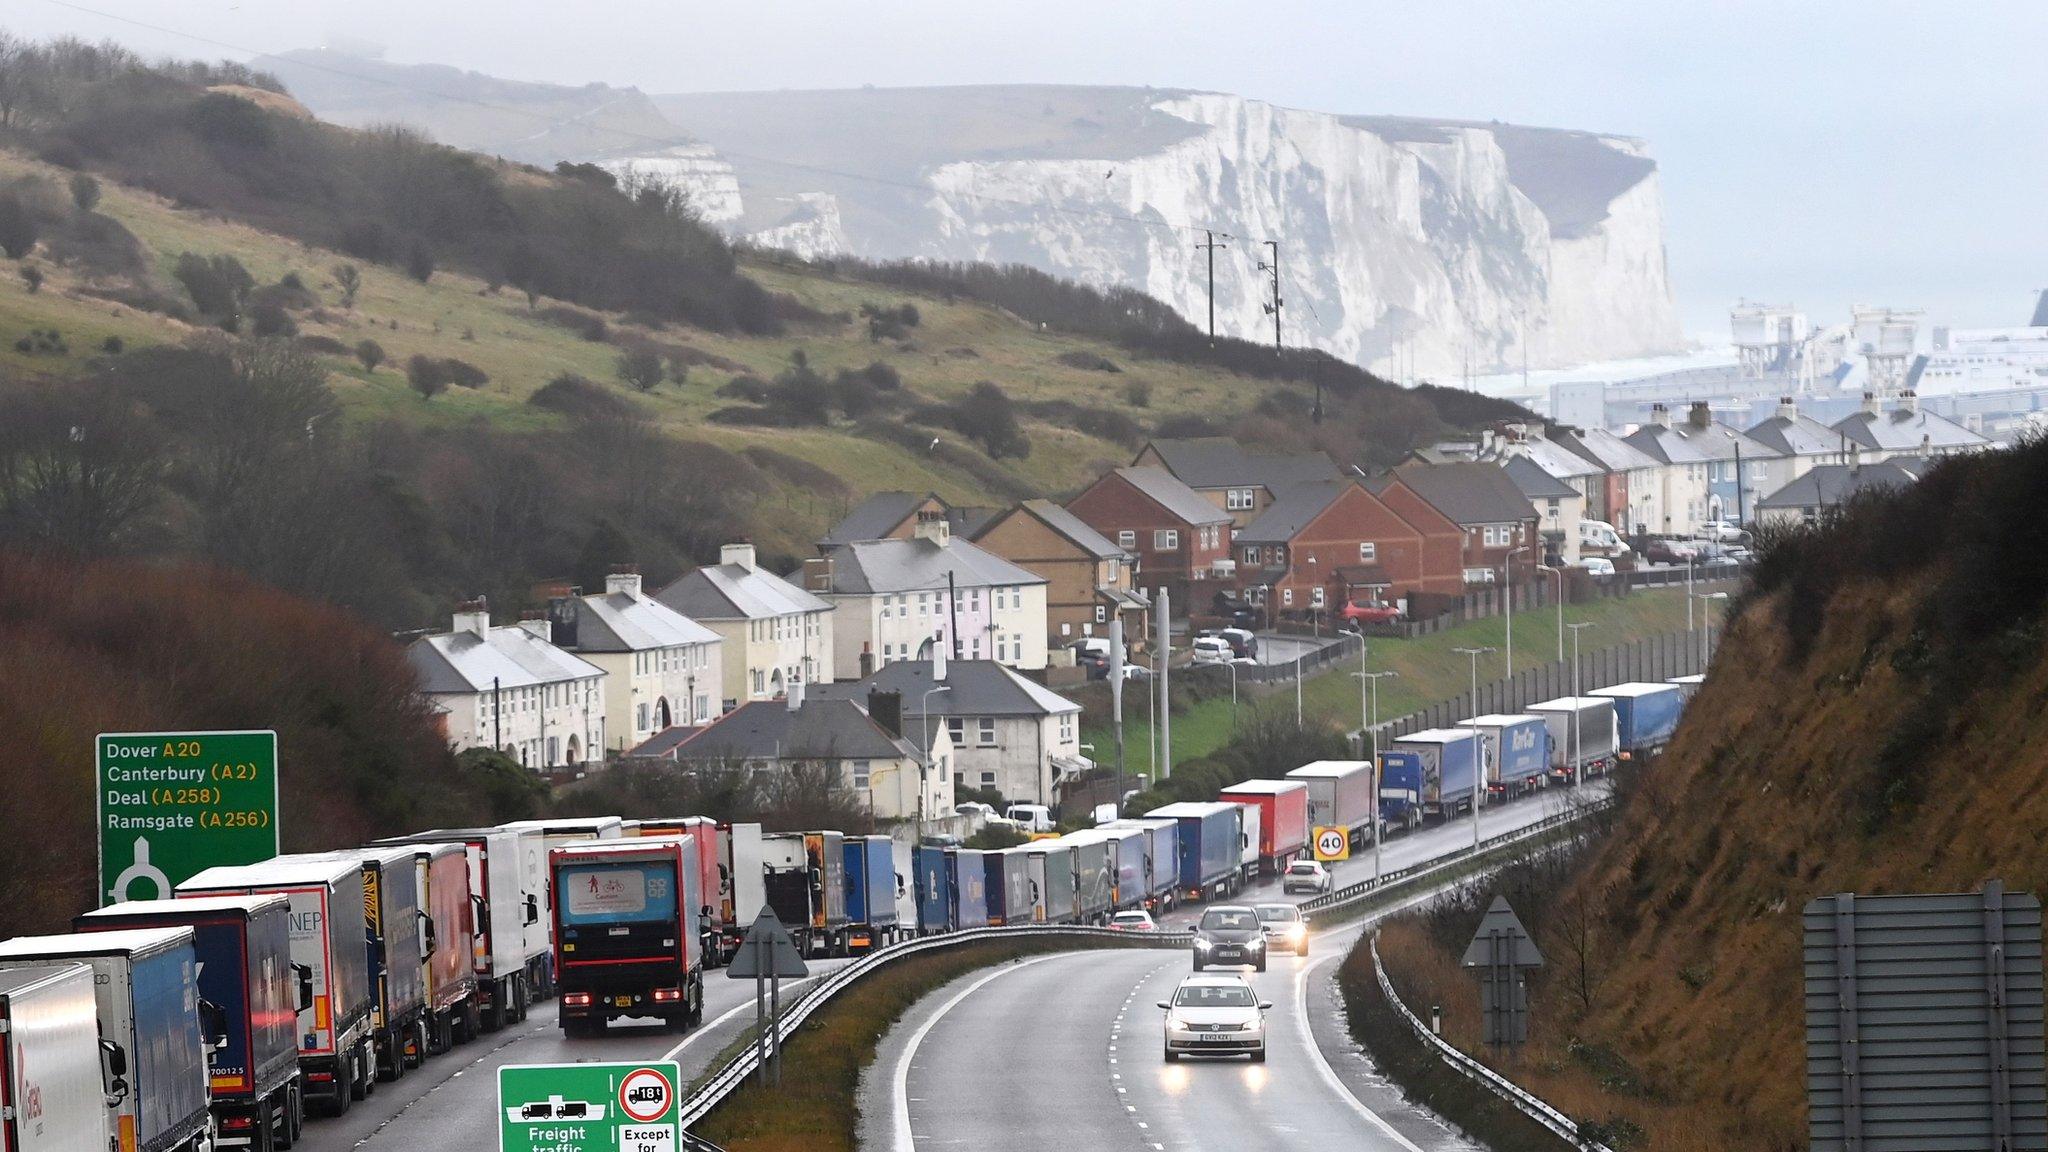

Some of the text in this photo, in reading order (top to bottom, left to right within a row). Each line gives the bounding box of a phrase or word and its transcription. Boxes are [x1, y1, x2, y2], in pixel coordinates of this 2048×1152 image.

[106, 742, 200, 758] Dover A20
[108, 763, 257, 782] Canterbury (A2)
[108, 787, 221, 806] Deal (A258)
[108, 810, 269, 830] Ramsgate (A256)
[1321, 837, 1341, 849] 40
[529, 1126, 586, 1142] Freight
[624, 1129, 670, 1141] Except
[638, 1143, 656, 1152] for
